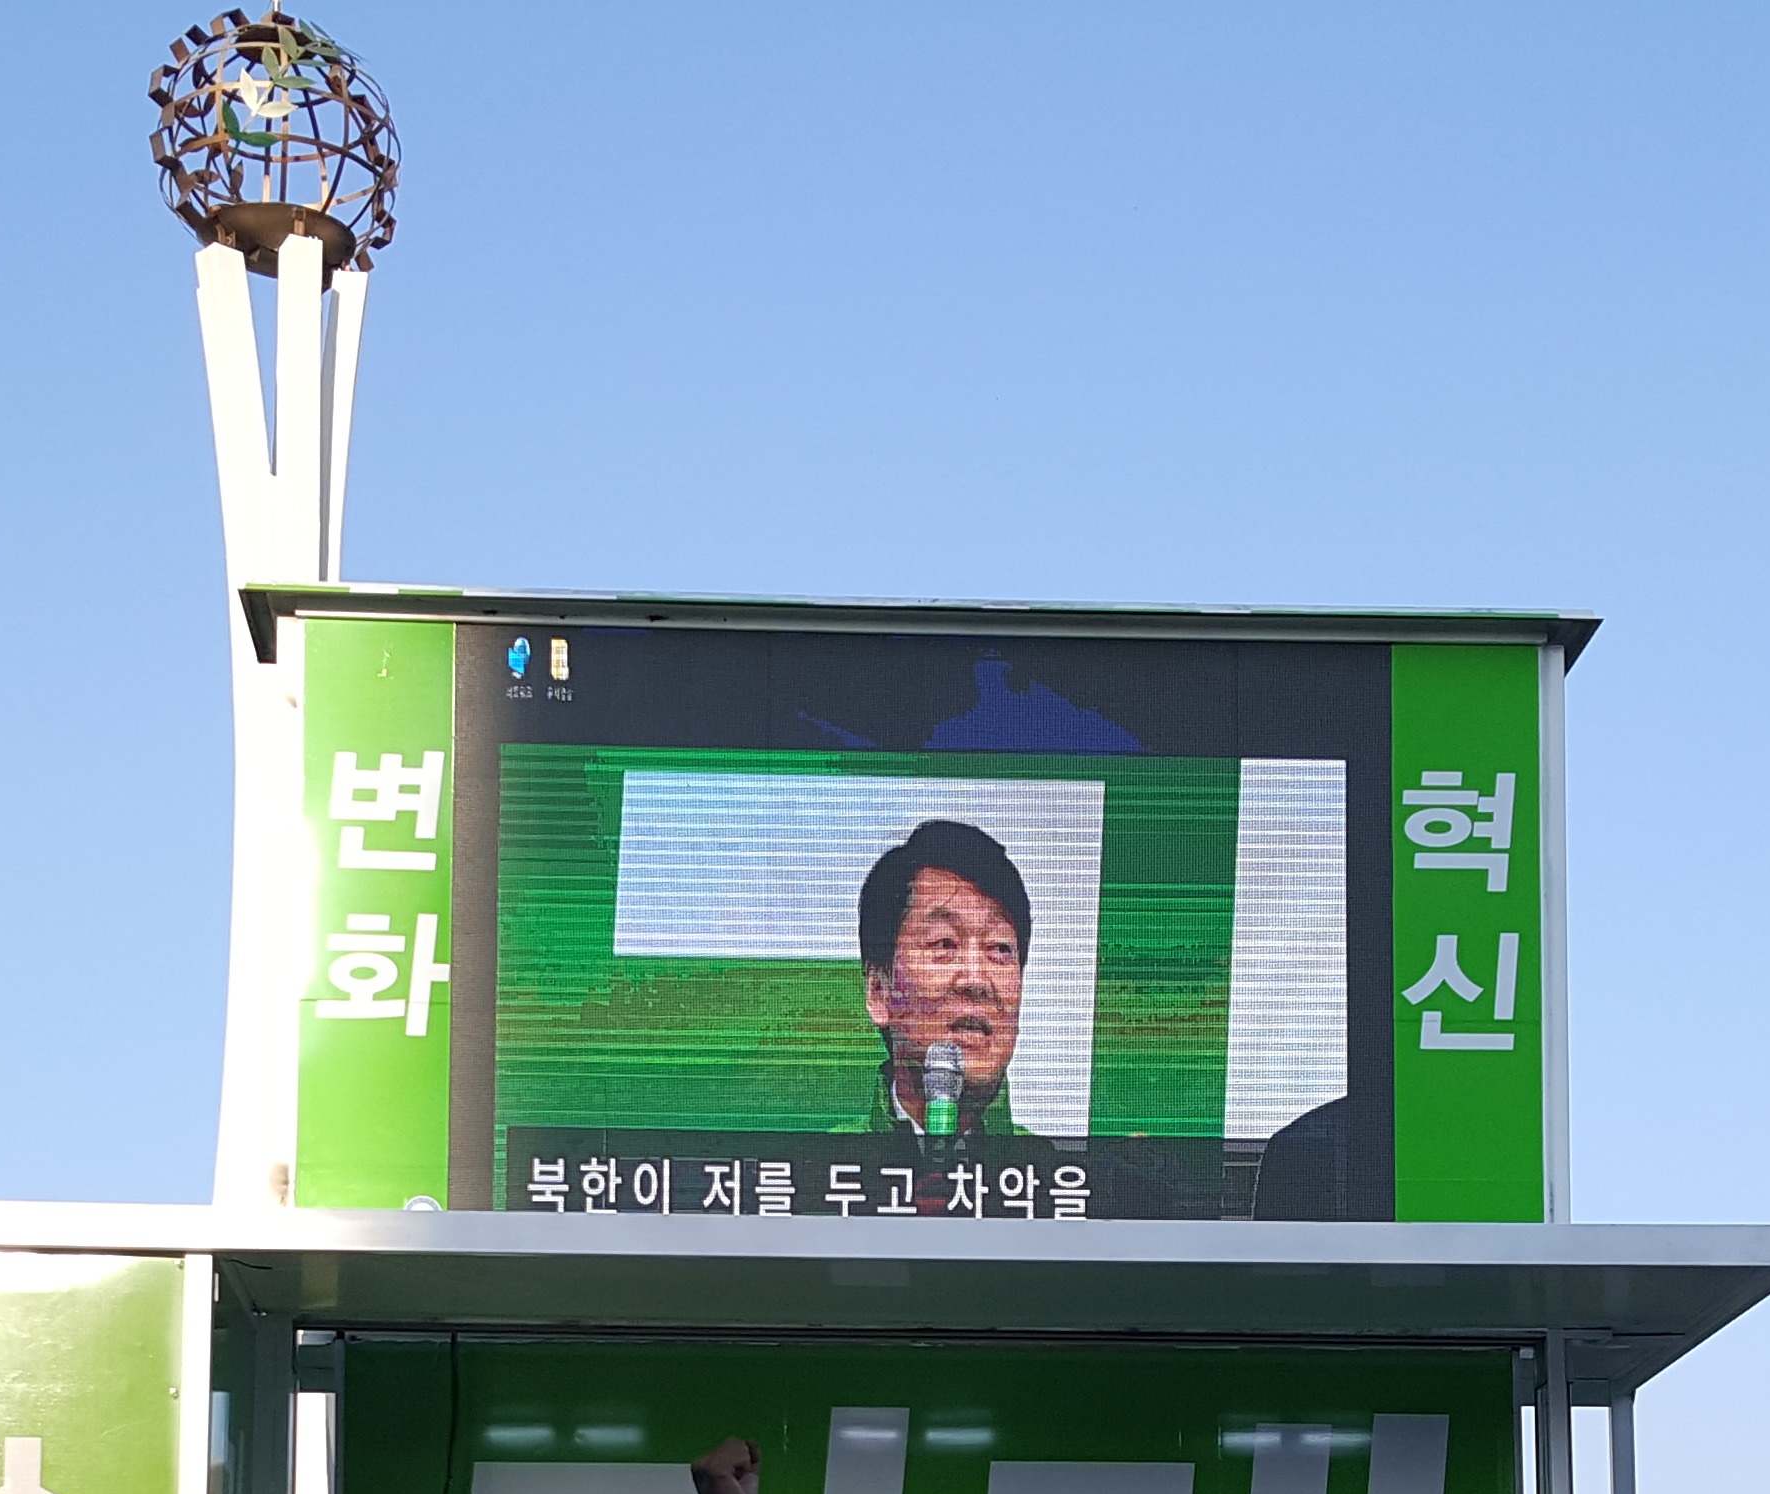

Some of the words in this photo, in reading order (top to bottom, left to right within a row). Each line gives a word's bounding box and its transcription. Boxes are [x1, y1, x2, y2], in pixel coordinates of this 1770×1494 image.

[317, 748, 448, 1038] 변화
[1399, 768, 1518, 1056] 혁신
[527, 1157, 672, 1215] 북한이
[701, 1160, 797, 1218] 저를
[825, 1163, 919, 1217] 두고
[947, 1165, 1092, 1221] 차악을
